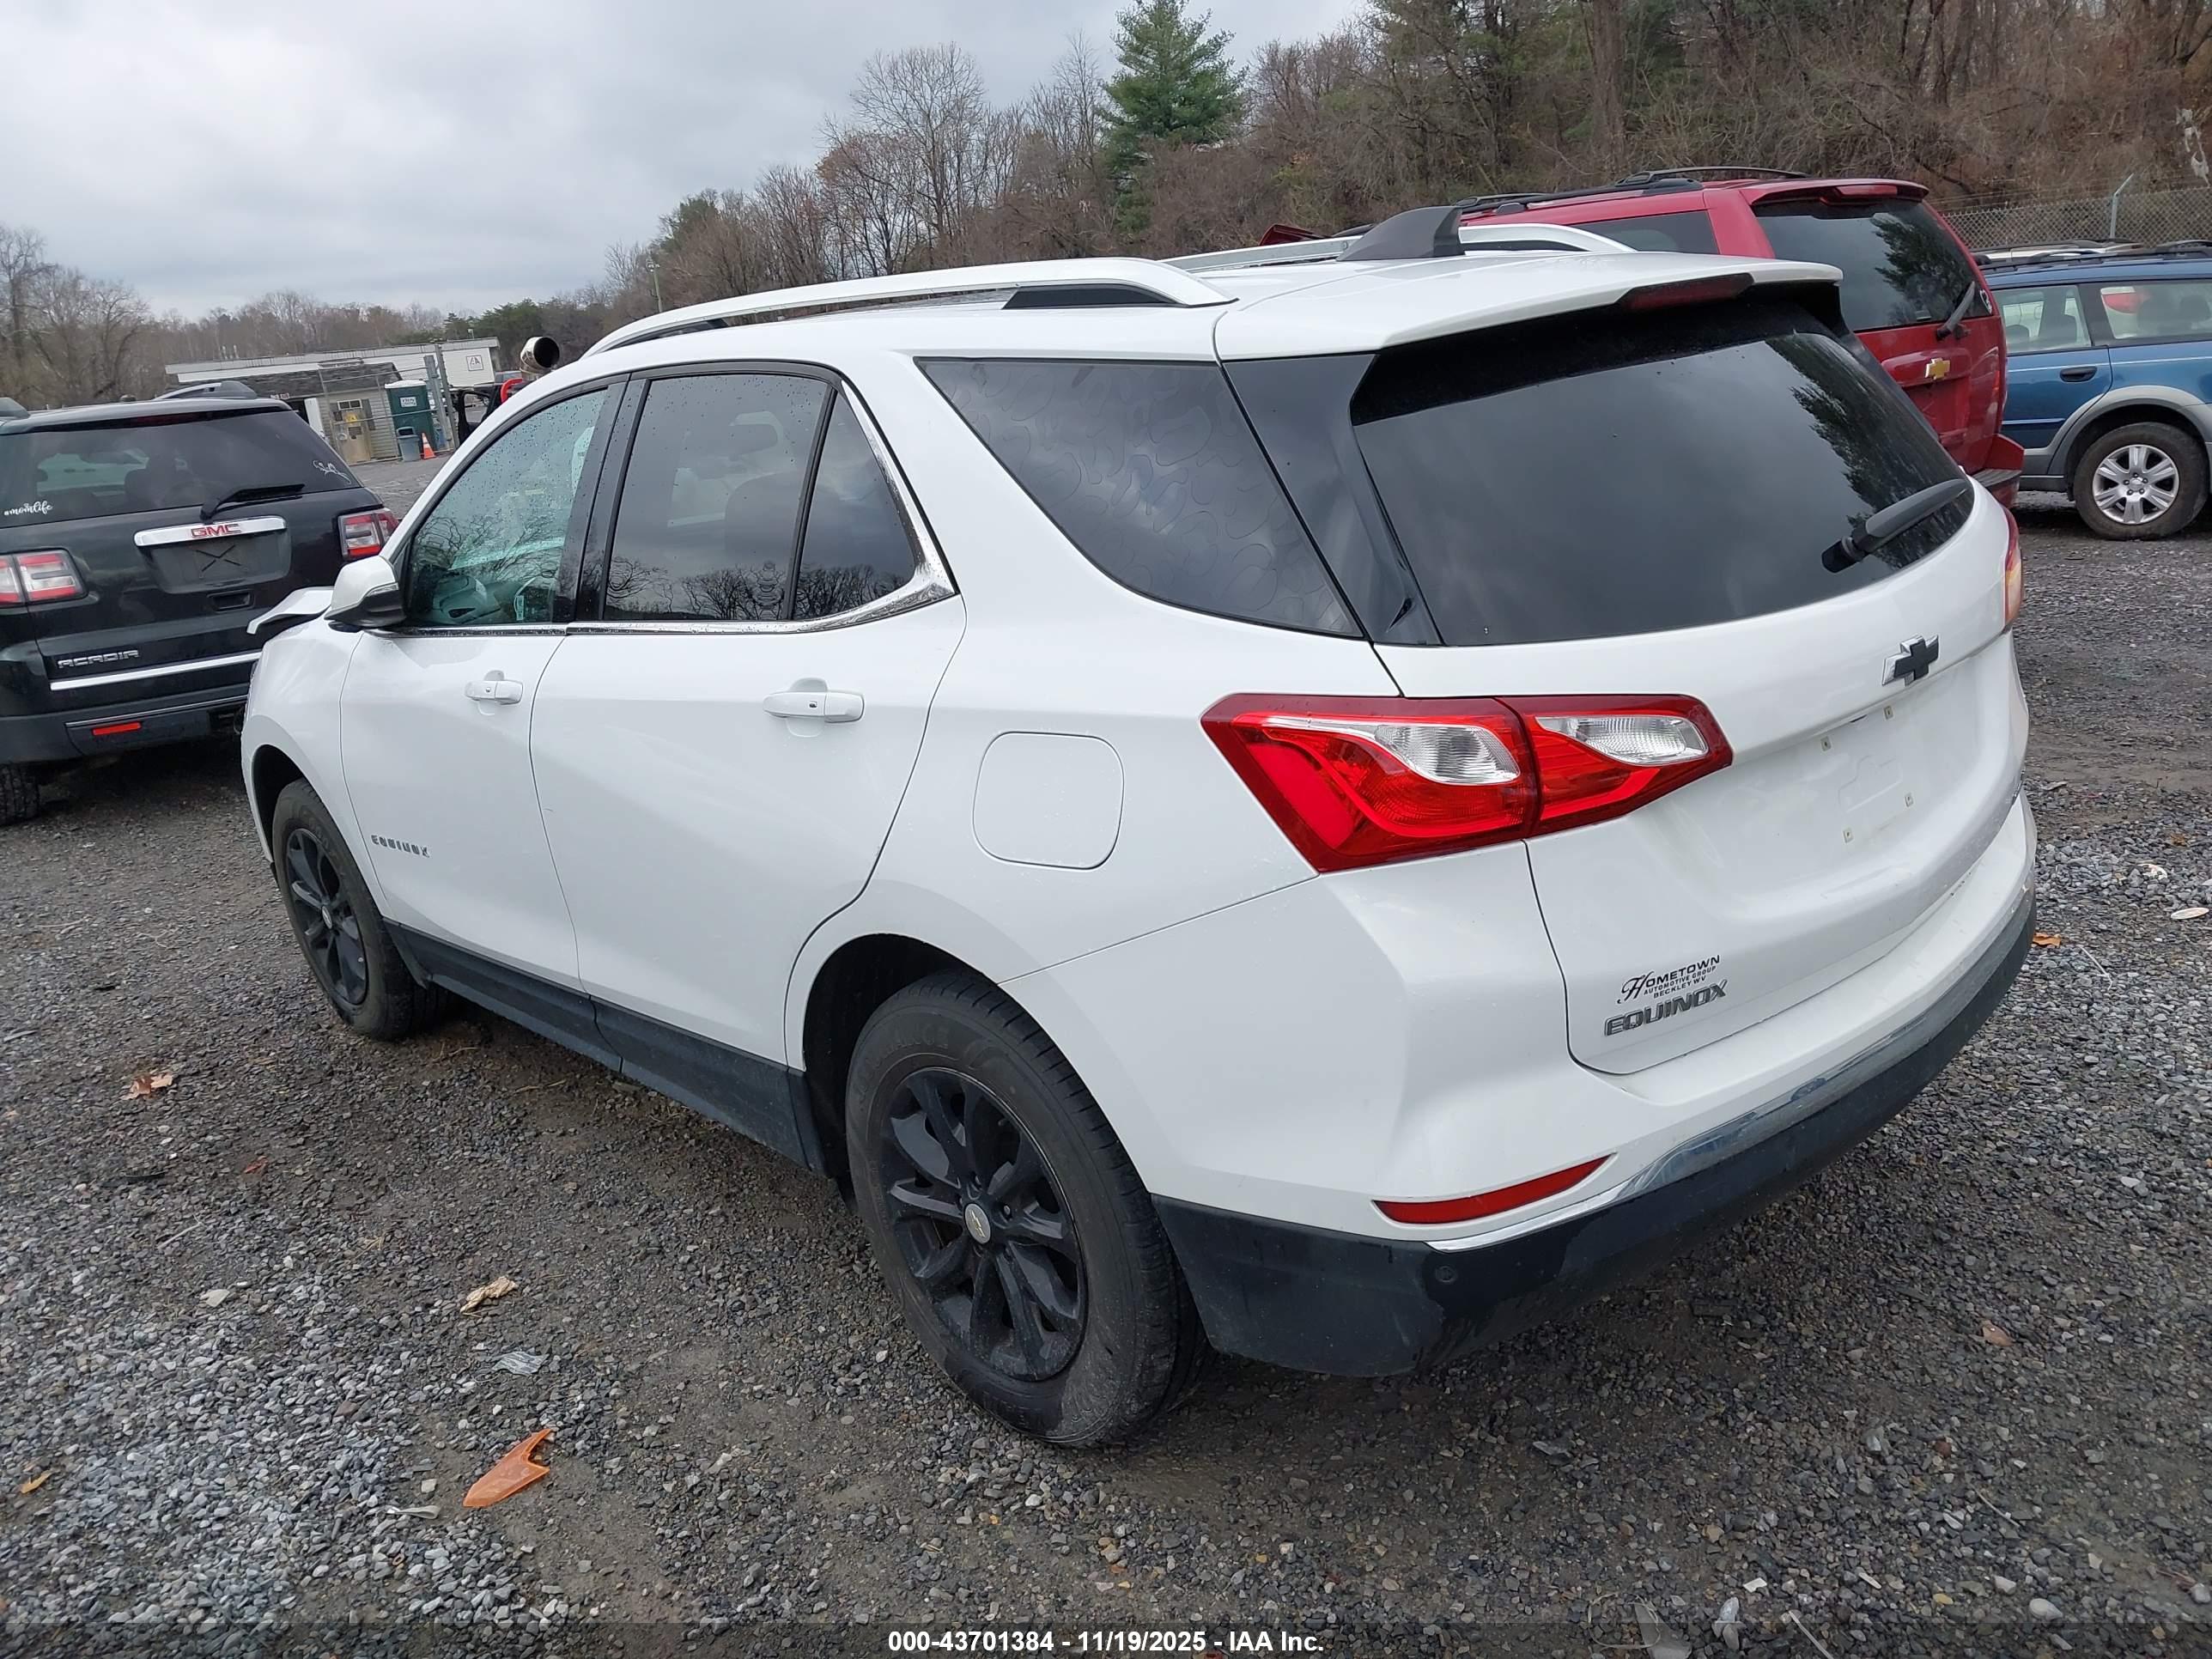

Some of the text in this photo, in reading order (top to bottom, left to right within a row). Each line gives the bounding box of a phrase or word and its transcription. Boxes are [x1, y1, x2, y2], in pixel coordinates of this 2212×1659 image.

[191, 523, 241, 538] GMC
[58, 650, 139, 669] ACADIA
[371, 835, 430, 858] EQUINOX
[1617, 955, 1720, 1004] HOMETOWN
[1644, 965, 1717, 995] AUTOMOTIVE GROUP
[1653, 981, 1692, 999] BECKLEY
[1604, 979, 1728, 1036] EQUINOX
